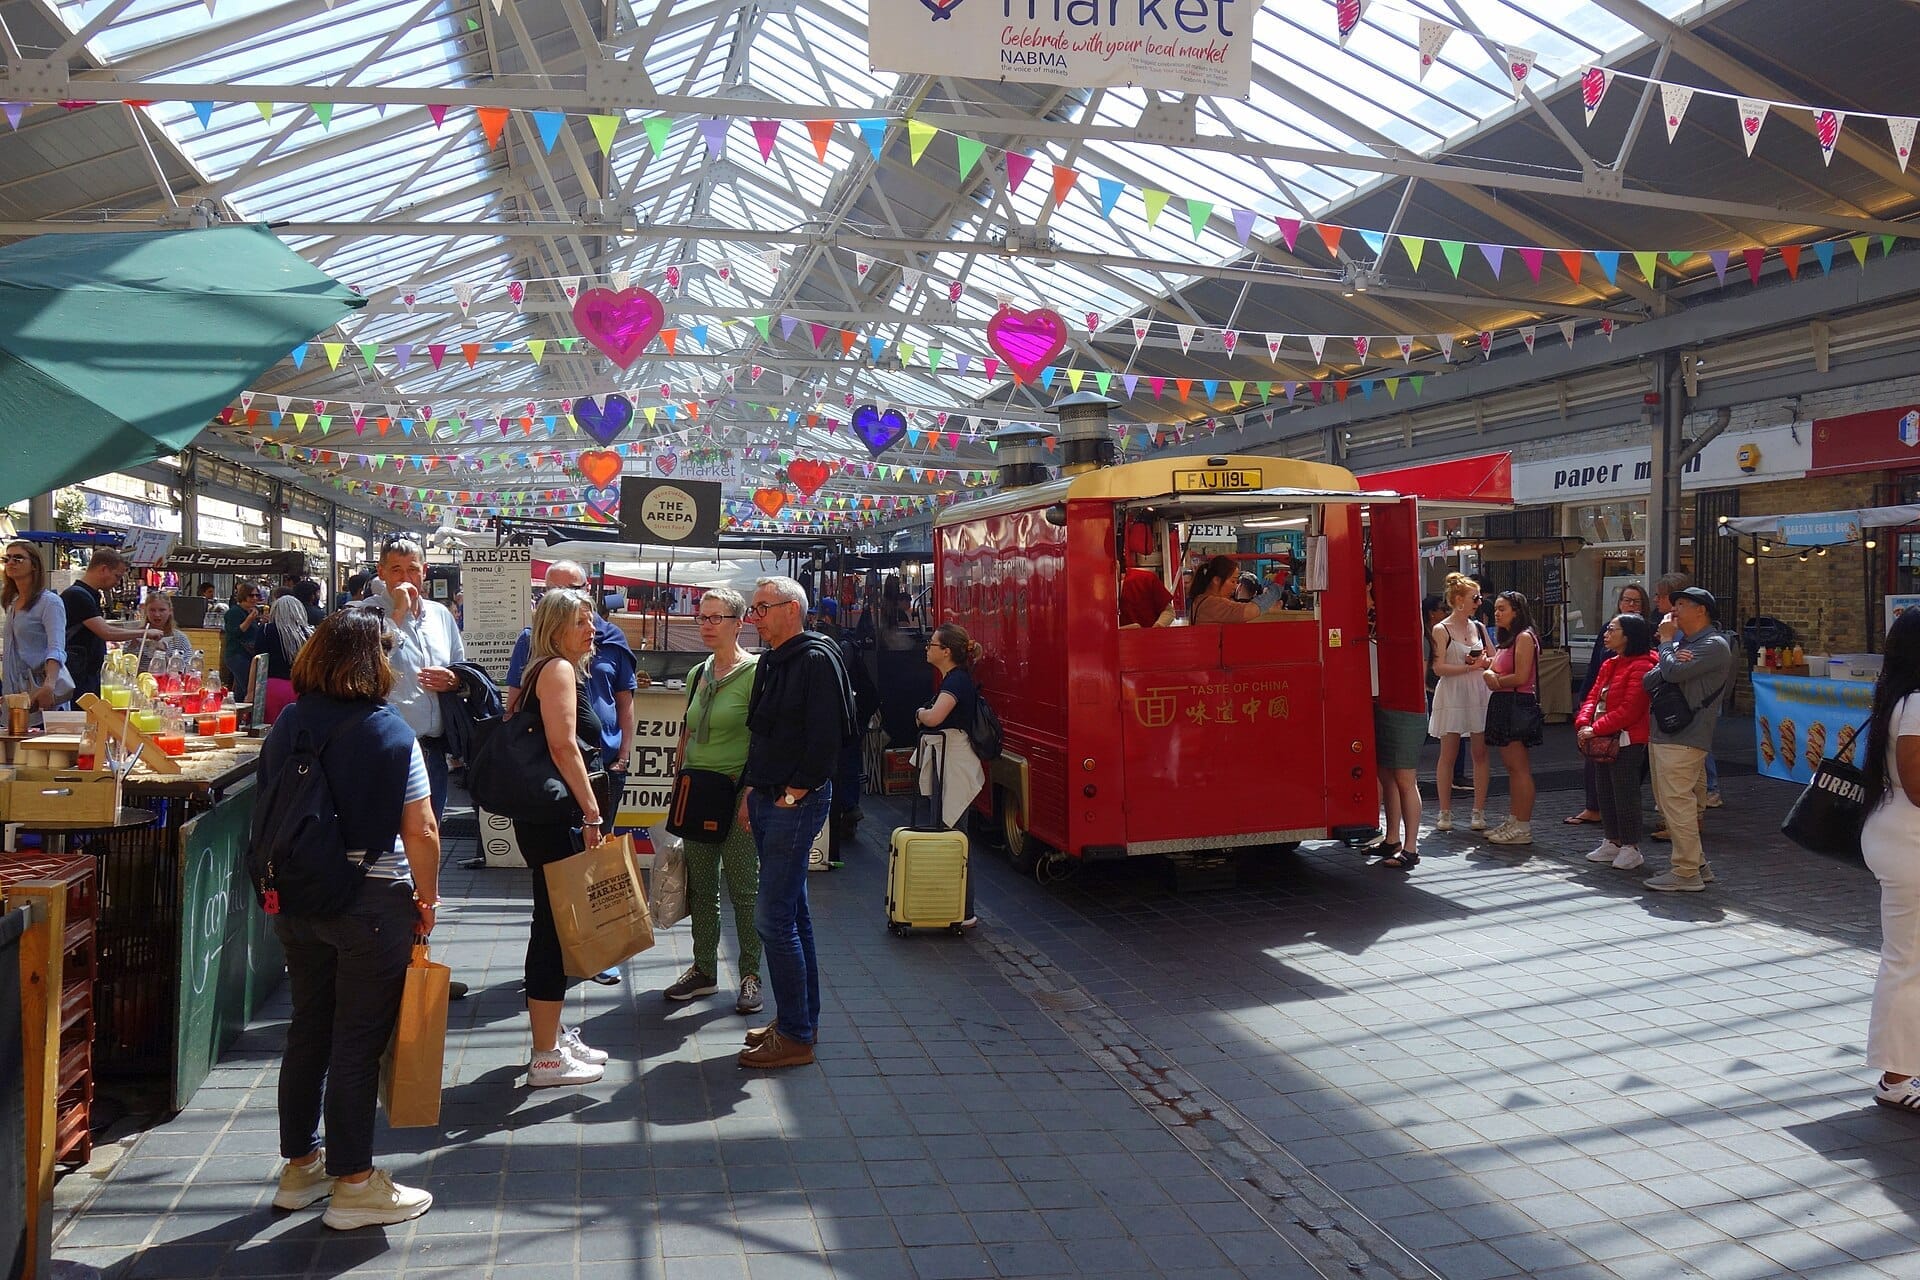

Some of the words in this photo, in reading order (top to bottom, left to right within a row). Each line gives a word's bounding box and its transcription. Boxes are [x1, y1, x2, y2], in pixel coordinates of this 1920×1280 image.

[1001, 25, 1069, 51] Celebrate
[1072, 31, 1103, 54] with
[1103, 36, 1143, 62] your
[1145, 34, 1178, 57] local
[1179, 38, 1229, 64] market
[1001, 49, 1068, 68] NABMA
[1032, 66, 1041, 74] of
[1043, 67, 1068, 77] markets
[1554, 463, 1622, 489] paper
[1634, 452, 1701, 480] mn
[1188, 472, 1218, 488] FAJ
[659, 501, 684, 511] THE
[647, 511, 693, 522] AREPA
[168, 554, 194, 563] eal
[198, 553, 272, 568] Espresso
[463, 550, 530, 562] AREPAS
[1191, 684, 1229, 696] TASTE
[1233, 683, 1250, 694] OF
[1252, 680, 1289, 692] CHINA
[588, 878, 632, 902] MARKET
[533, 1060, 561, 1069] LONDON
